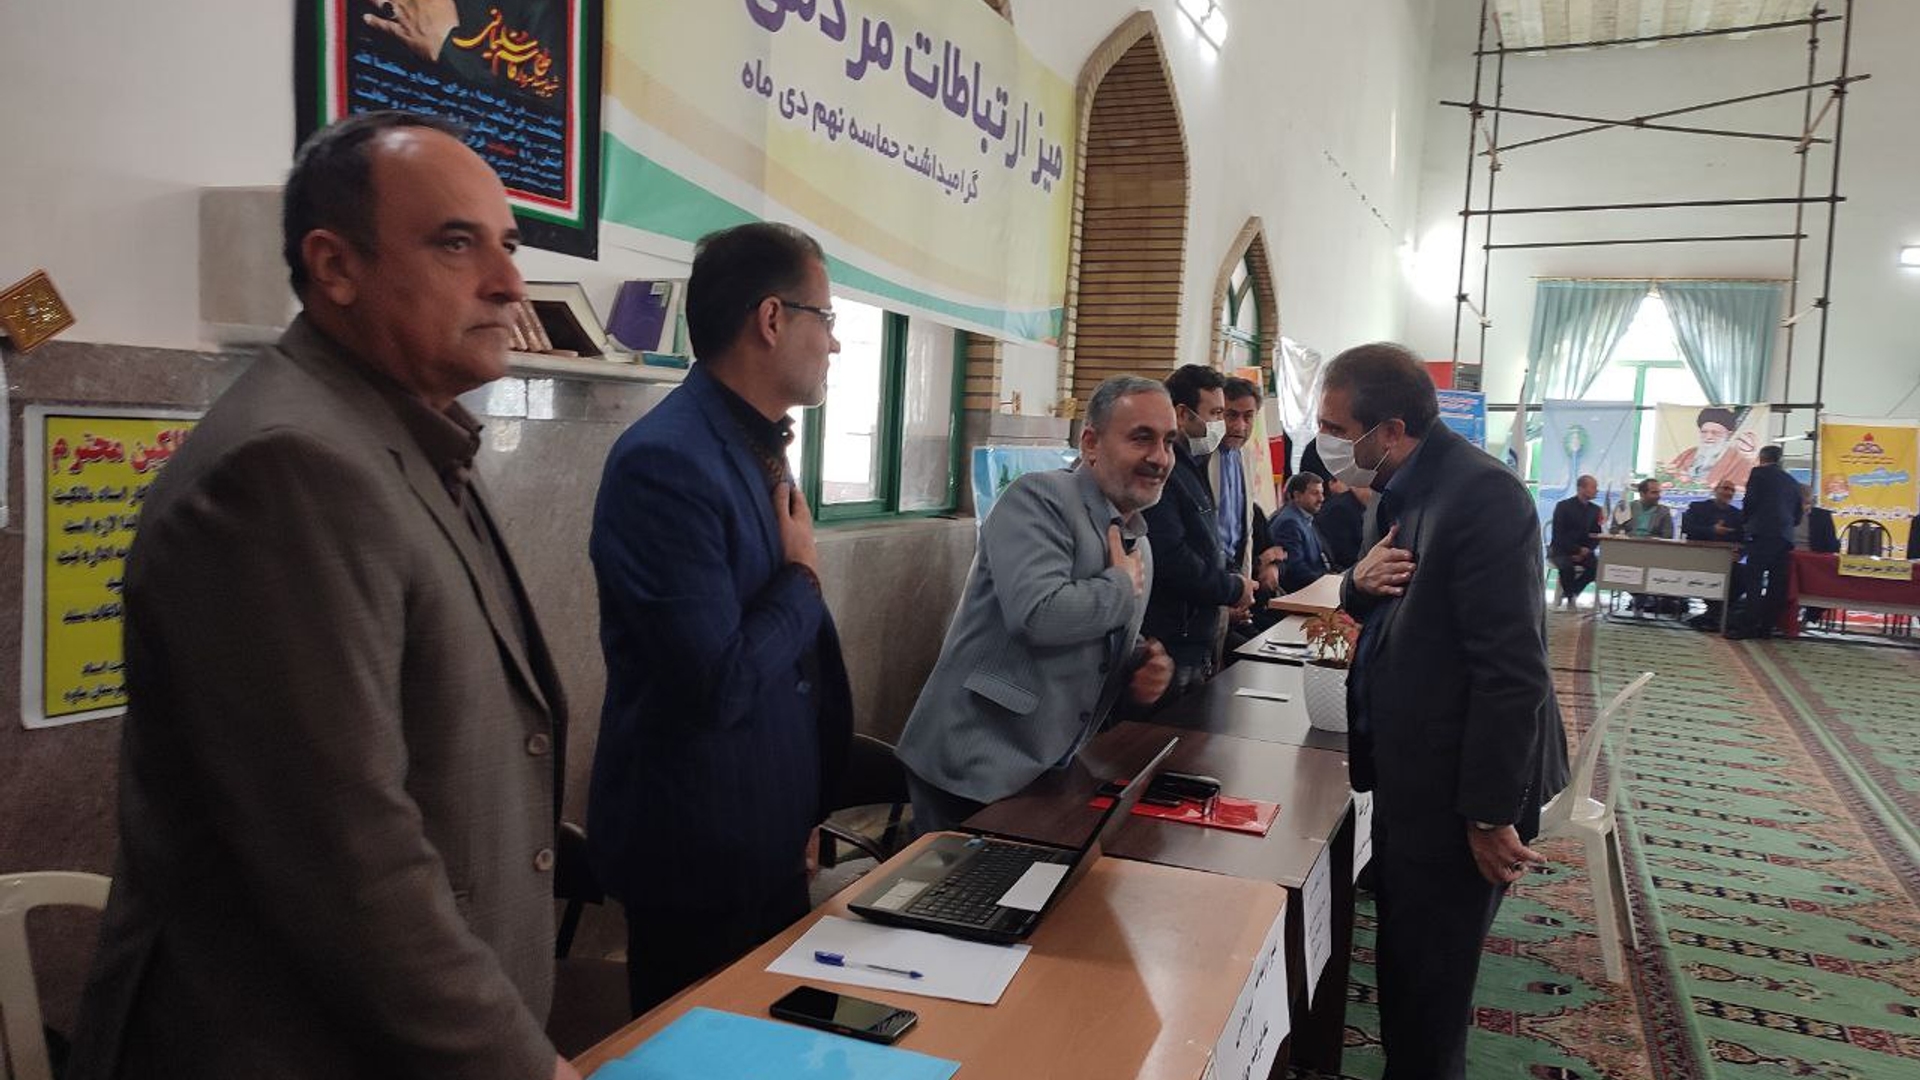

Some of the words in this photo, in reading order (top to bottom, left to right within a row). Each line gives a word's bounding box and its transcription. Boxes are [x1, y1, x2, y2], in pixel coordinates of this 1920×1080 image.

[741, 58, 773, 98] ماه
[778, 86, 808, 120] دی
[904, 31, 1029, 170] ارتباطات
[812, 102, 846, 142] نهم
[849, 122, 900, 160] حماسه
[1031, 111, 1063, 193] میز
[903, 144, 979, 204] گرامیداشت
[51, 432, 125, 475] محترم
